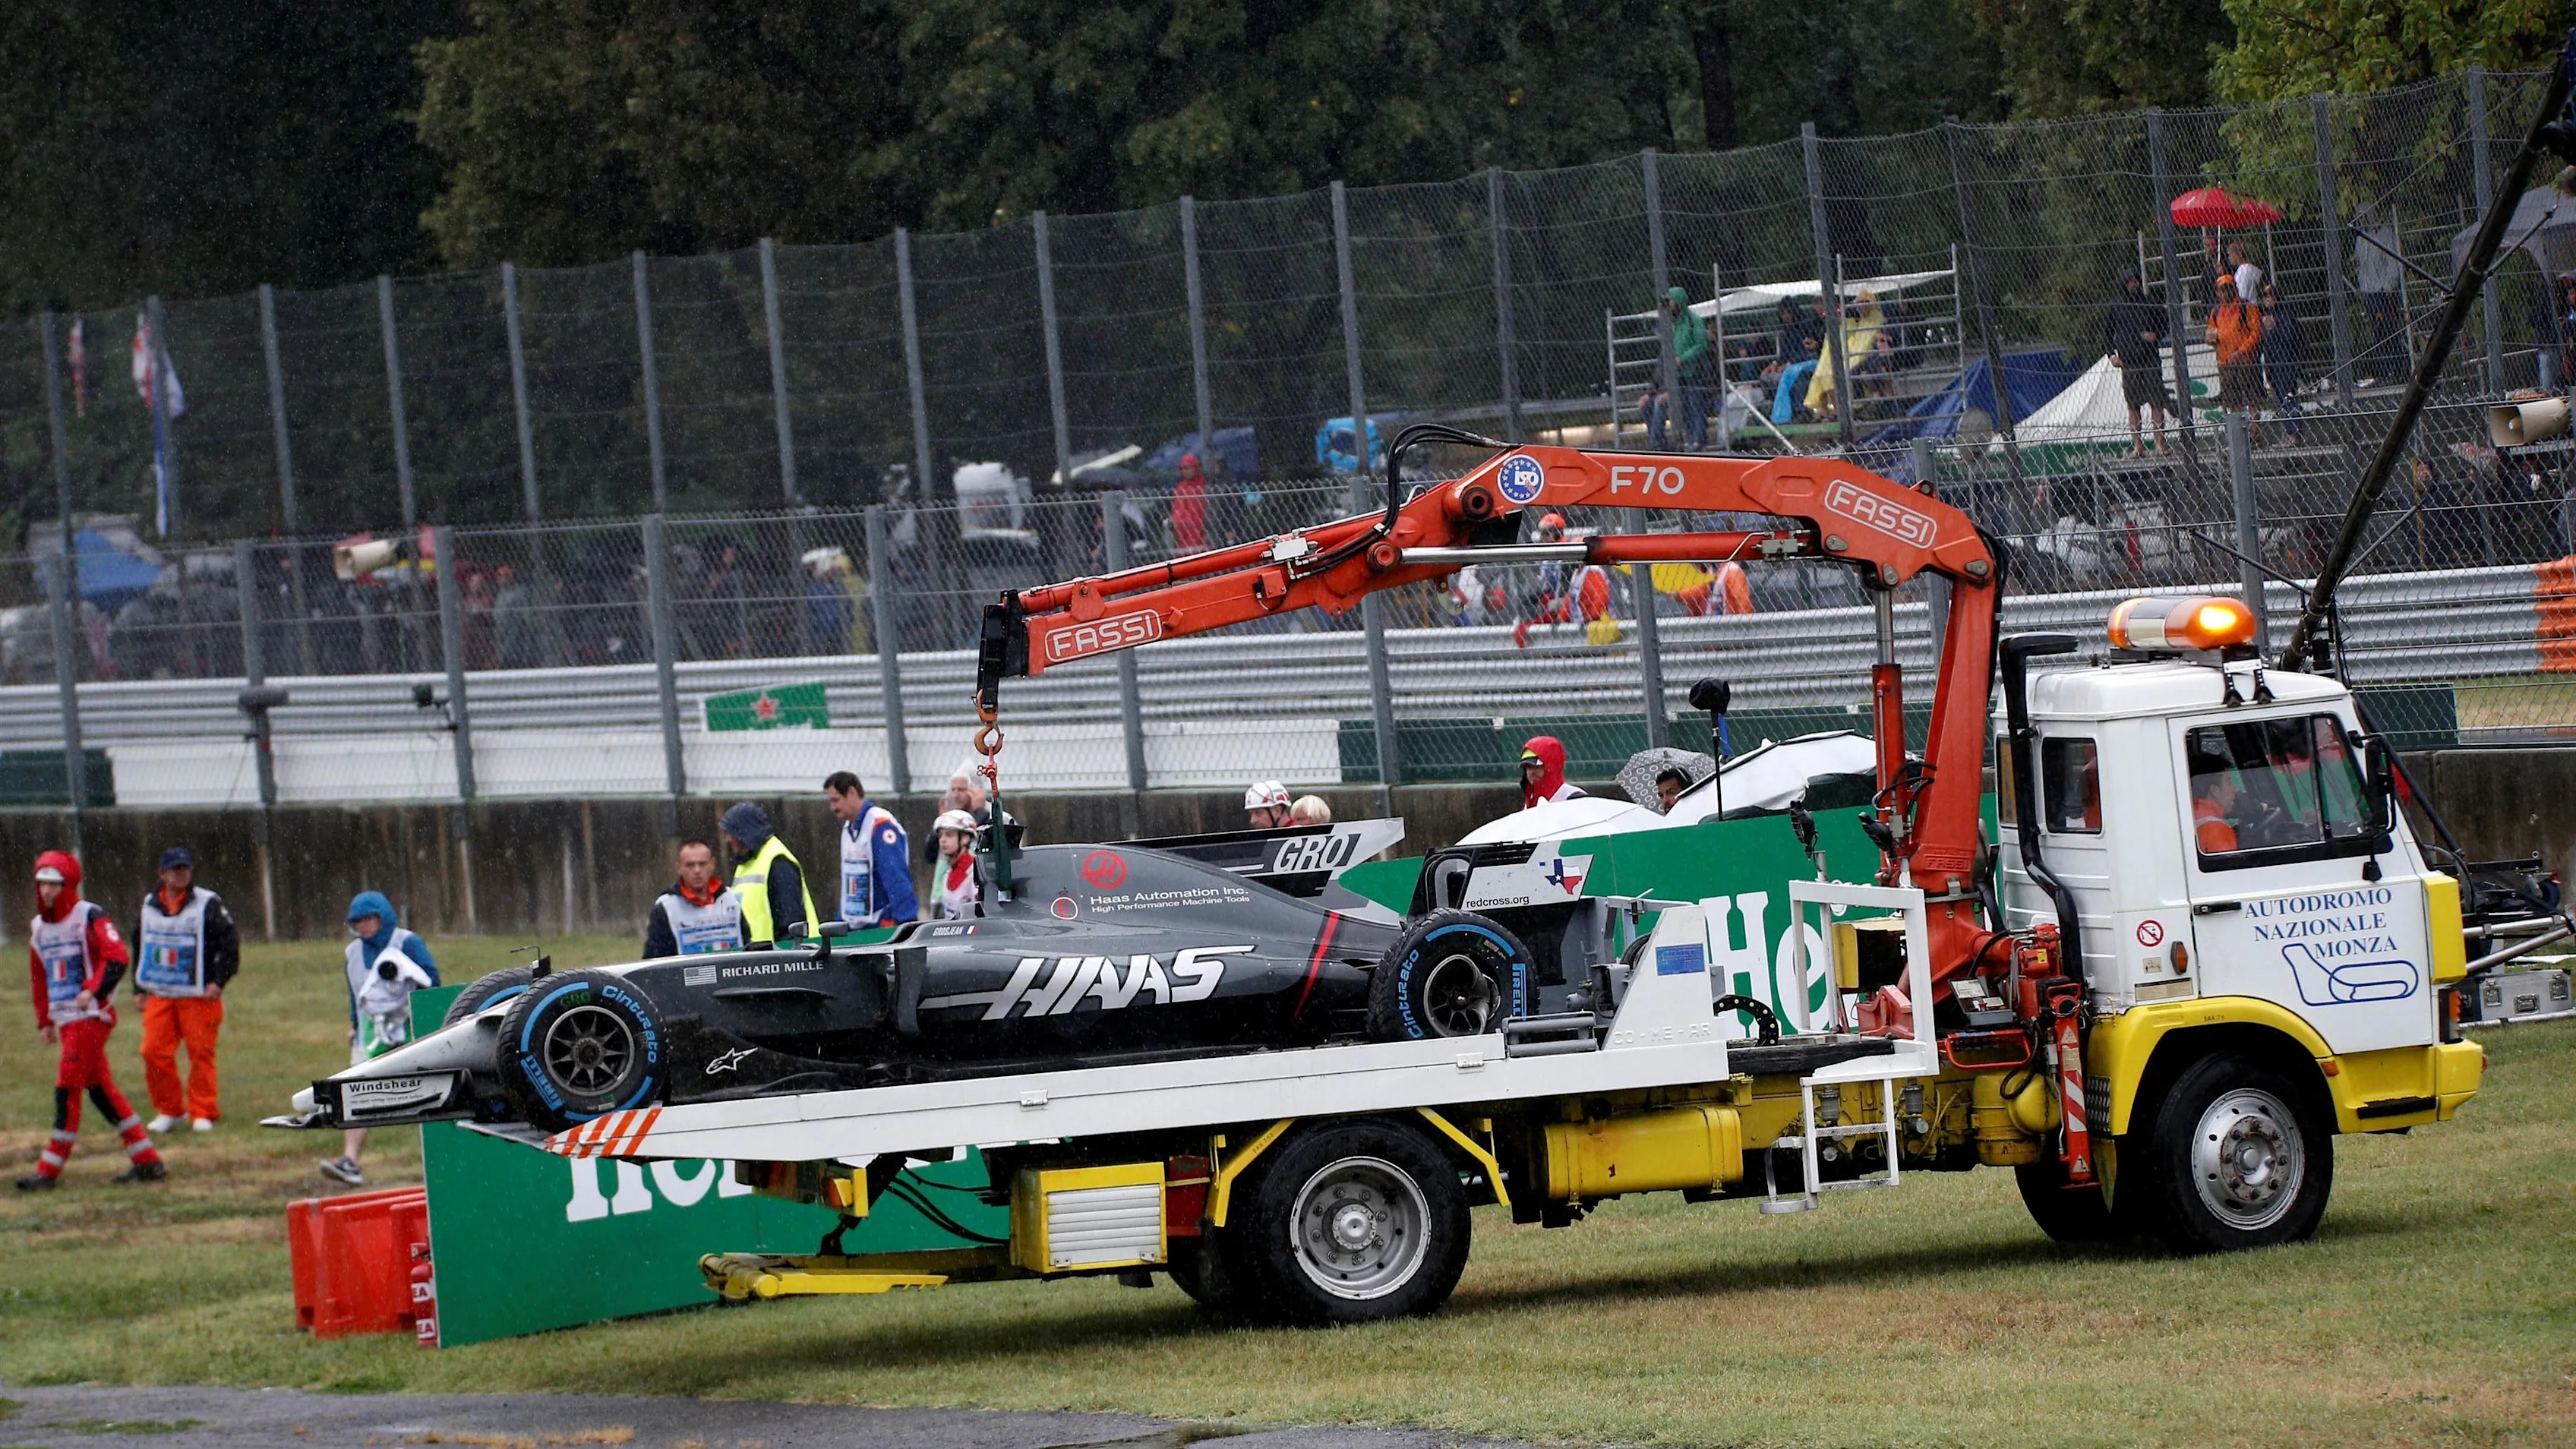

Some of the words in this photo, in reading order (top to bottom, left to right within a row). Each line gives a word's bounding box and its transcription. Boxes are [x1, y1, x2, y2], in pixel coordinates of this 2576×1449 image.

[1611, 466, 1685, 494] F70
[1833, 485, 1929, 543] FASSI
[1053, 615, 1154, 657] FASSI
[1273, 834, 1350, 873] GRO
[1927, 857, 1969, 870] FASSI
[1091, 895, 1130, 905] Haas
[1135, 888, 1220, 901] Automation
[1223, 886, 1249, 895] Inc.
[1118, 901, 1180, 911] Performance
[1182, 897, 1223, 906] Machine
[1466, 896, 1530, 908] redcross.org
[2245, 888, 2392, 918] AUTODROMO
[933, 926, 964, 936] GROSJEAN
[2254, 912, 2388, 942] NAZIONALE
[2315, 936, 2398, 959] MONZA
[722, 964, 780, 977] RICHARD
[784, 961, 824, 973] MILLE
[917, 945, 1257, 1021] HAAS
[1398, 949, 1424, 1039] Cinturato
[1512, 963, 1527, 1020] PIRELL
[601, 984, 658, 1063] Cinturato
[349, 1079, 422, 1092] Windshear
[520, 1054, 564, 1111] PIRELLI
